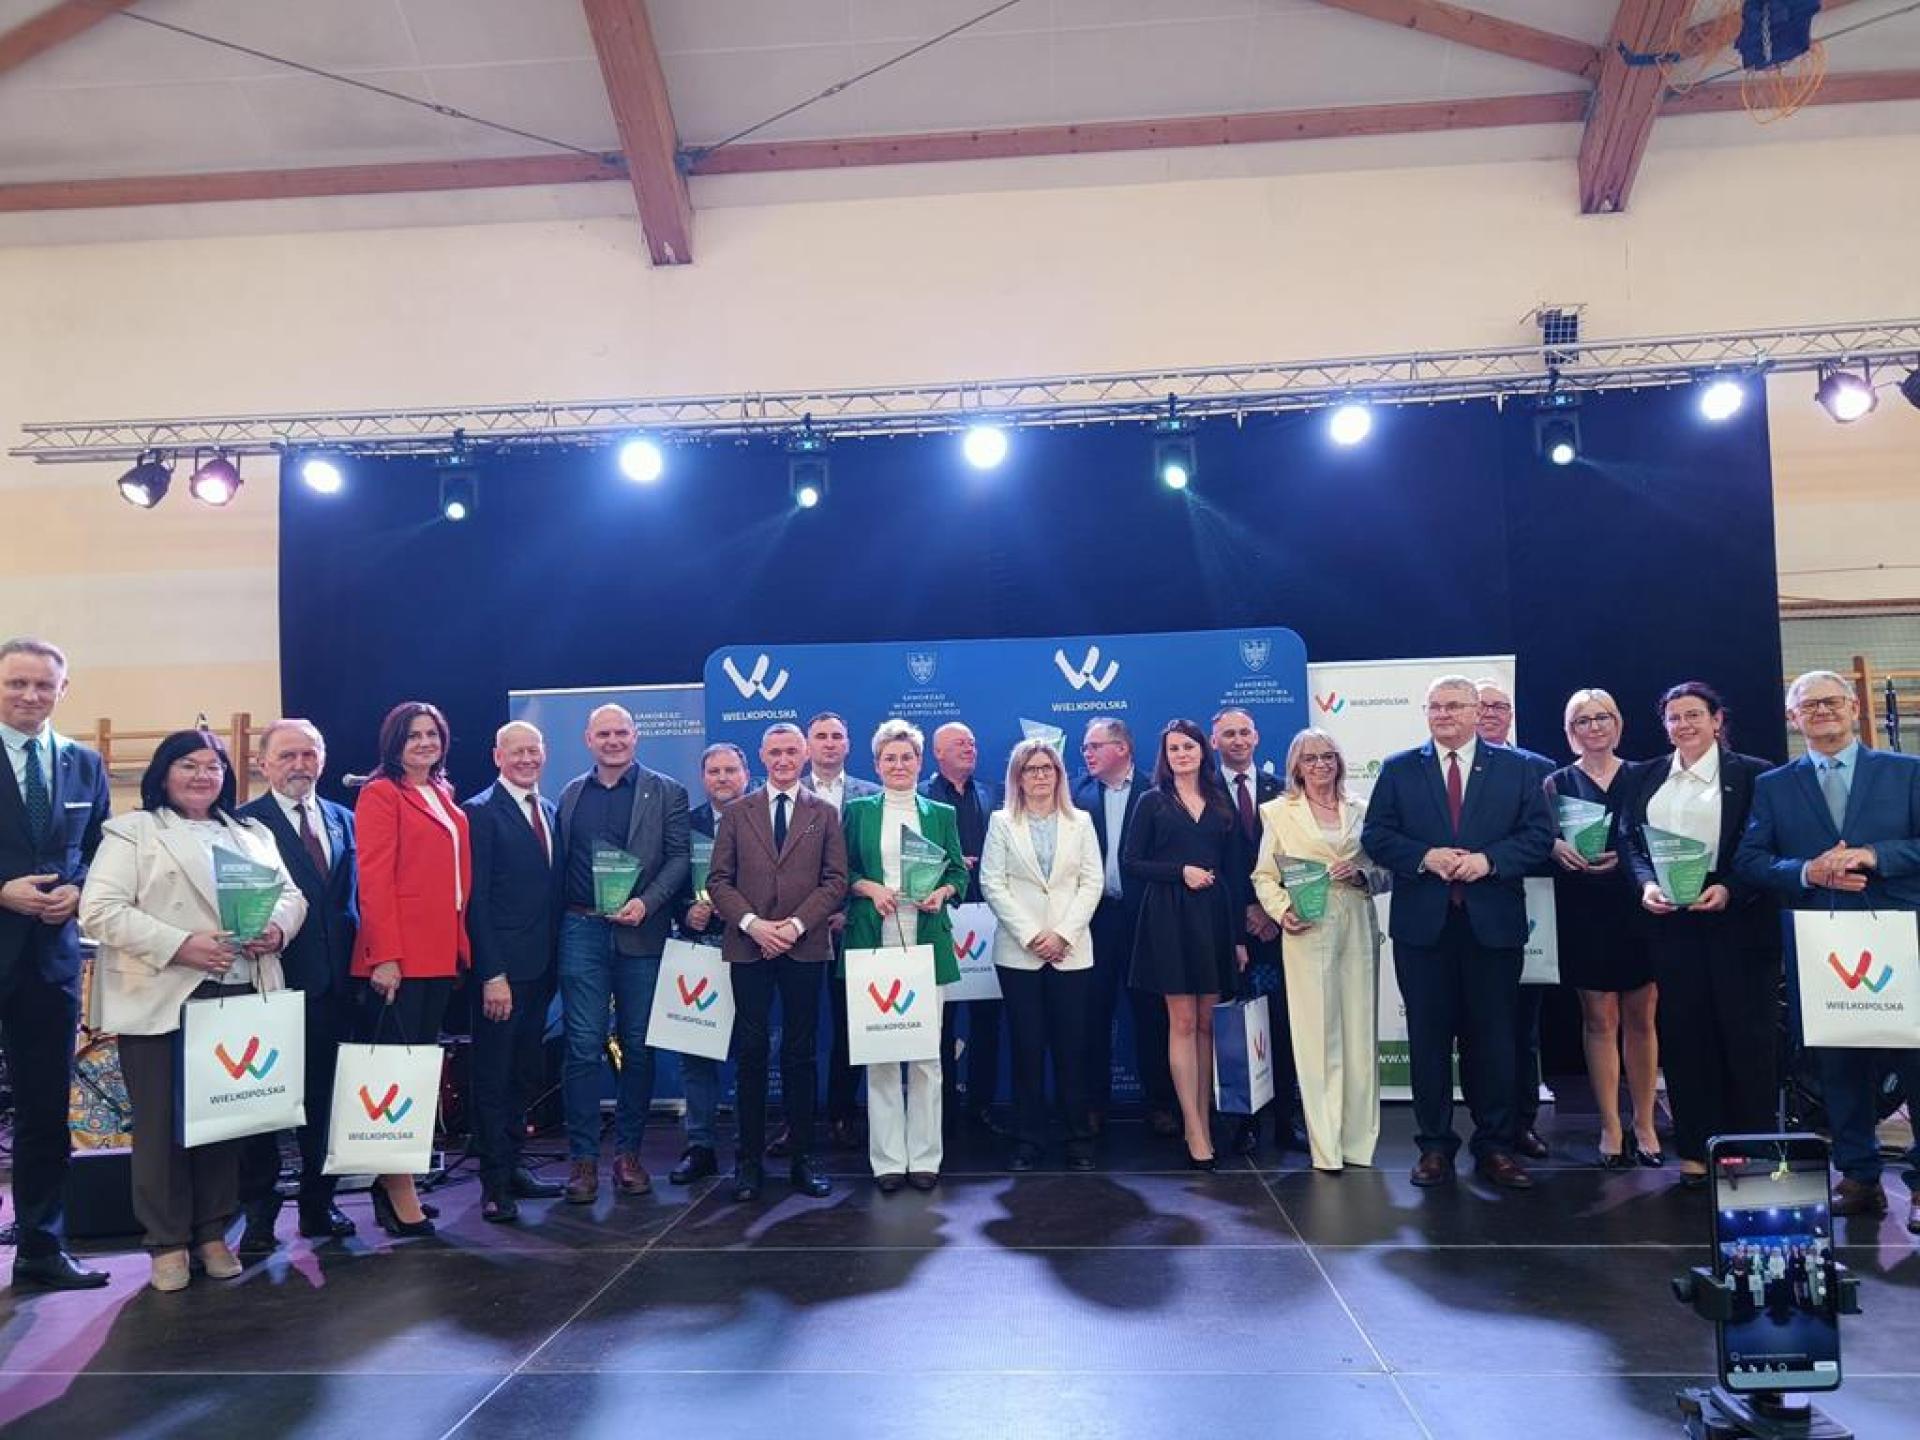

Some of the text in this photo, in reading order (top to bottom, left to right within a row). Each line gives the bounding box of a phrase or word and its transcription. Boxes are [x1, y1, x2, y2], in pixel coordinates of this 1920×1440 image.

[1052, 701, 1127, 712] WIELKOPOLSKA
[1350, 698, 1409, 706] WIELKOPOLSKA
[722, 709, 797, 721] WIELKOPOLSKA
[1825, 1000, 1904, 1011] WIELKOPOLSKA
[667, 1012, 717, 1028] WIELKOPOLSKA
[865, 1021, 923, 1031] WIELKOPOLSKA
[209, 1085, 286, 1104] WIELKOPOLSKA
[348, 1132, 415, 1141] WIELKOPOLSKA
